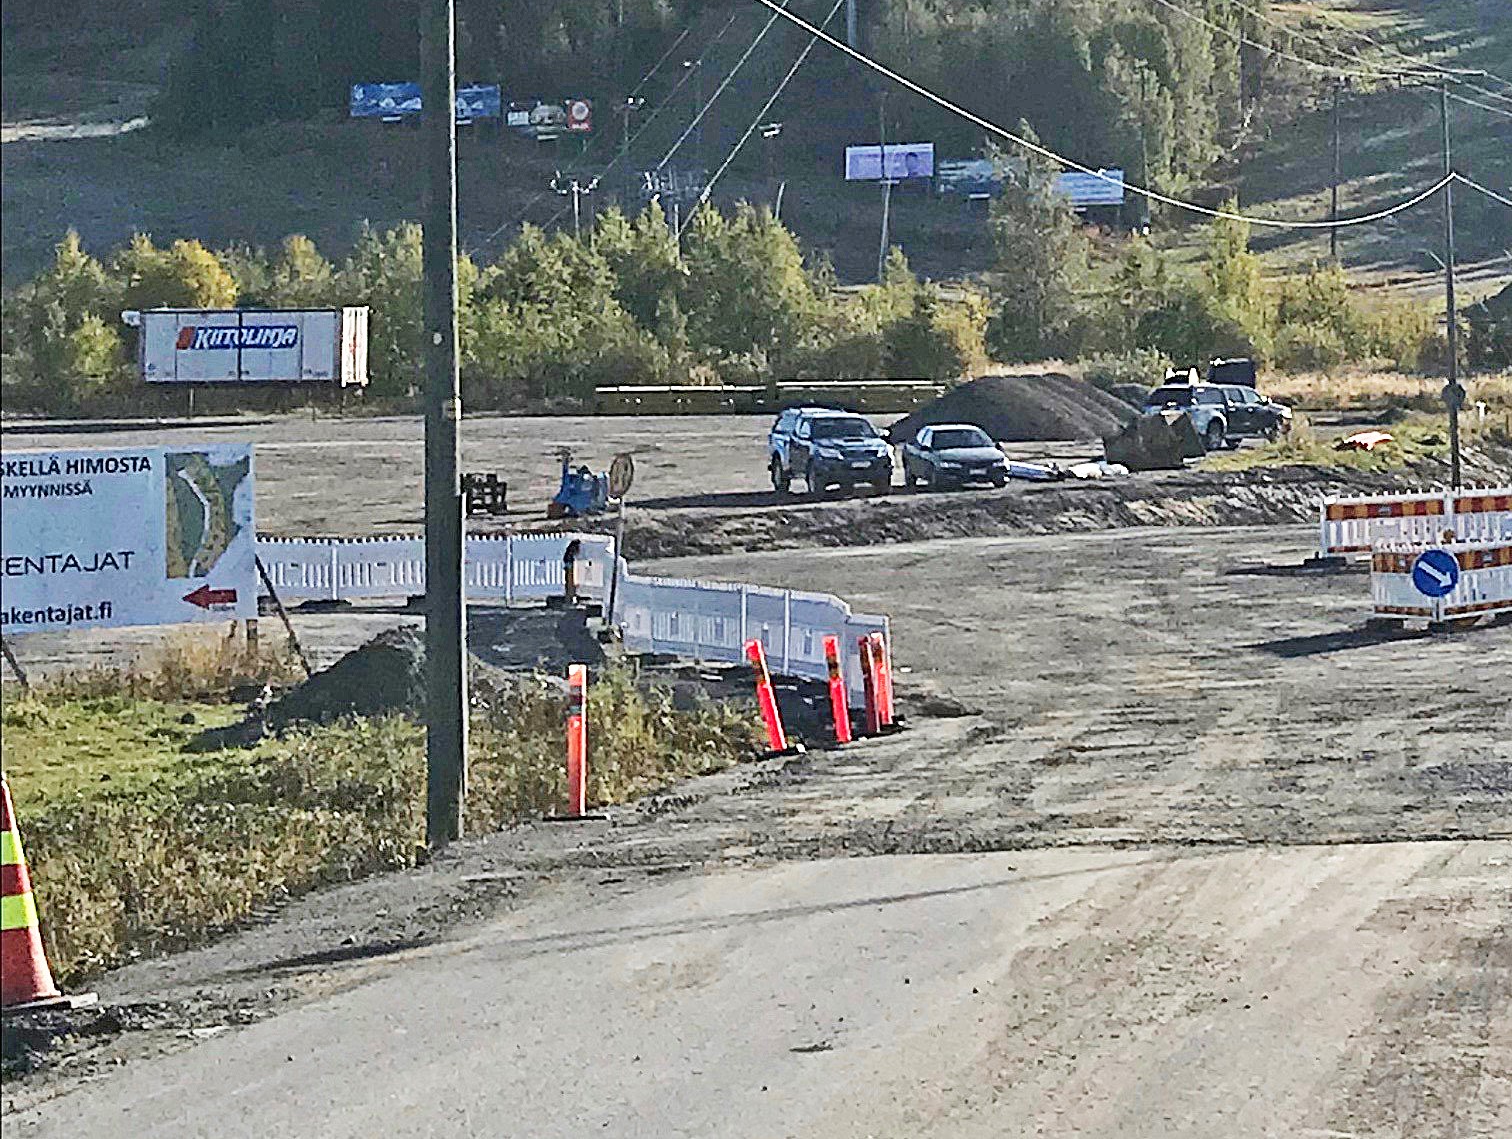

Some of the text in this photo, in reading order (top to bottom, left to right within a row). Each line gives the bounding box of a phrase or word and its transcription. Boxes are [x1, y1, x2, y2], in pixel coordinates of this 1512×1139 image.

[66, 456, 152, 475] HIMOSTA
[3, 479, 94, 499] MYYNNISSÄ
[0, 551, 135, 577] ENTAJAT
